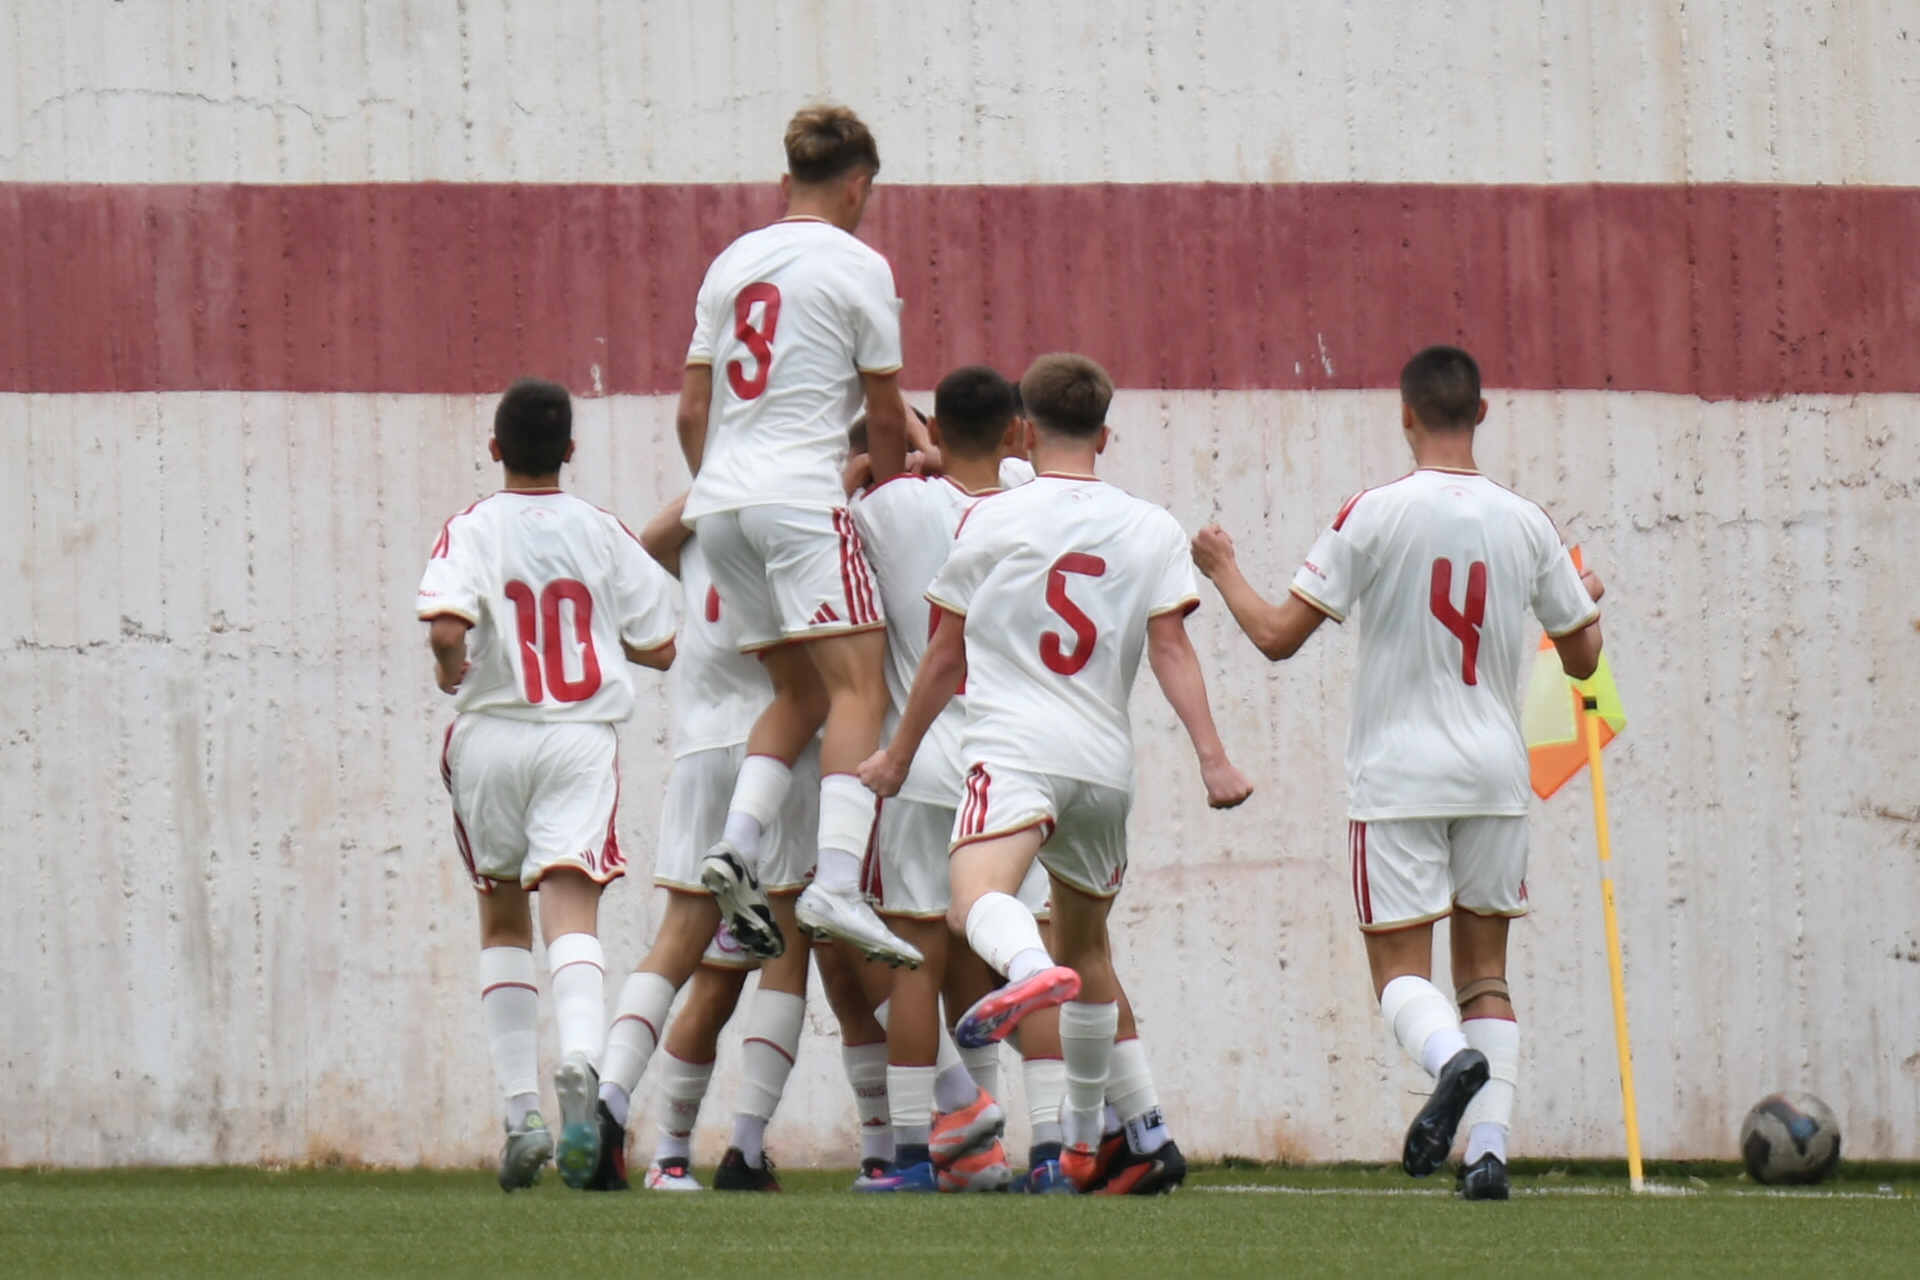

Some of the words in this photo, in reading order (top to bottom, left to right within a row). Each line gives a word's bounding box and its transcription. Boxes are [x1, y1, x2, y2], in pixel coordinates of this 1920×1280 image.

[728, 282, 781, 400] 9
[504, 578, 602, 704] 10
[1039, 552, 1106, 676] 5
[1429, 557, 1487, 686] 4
